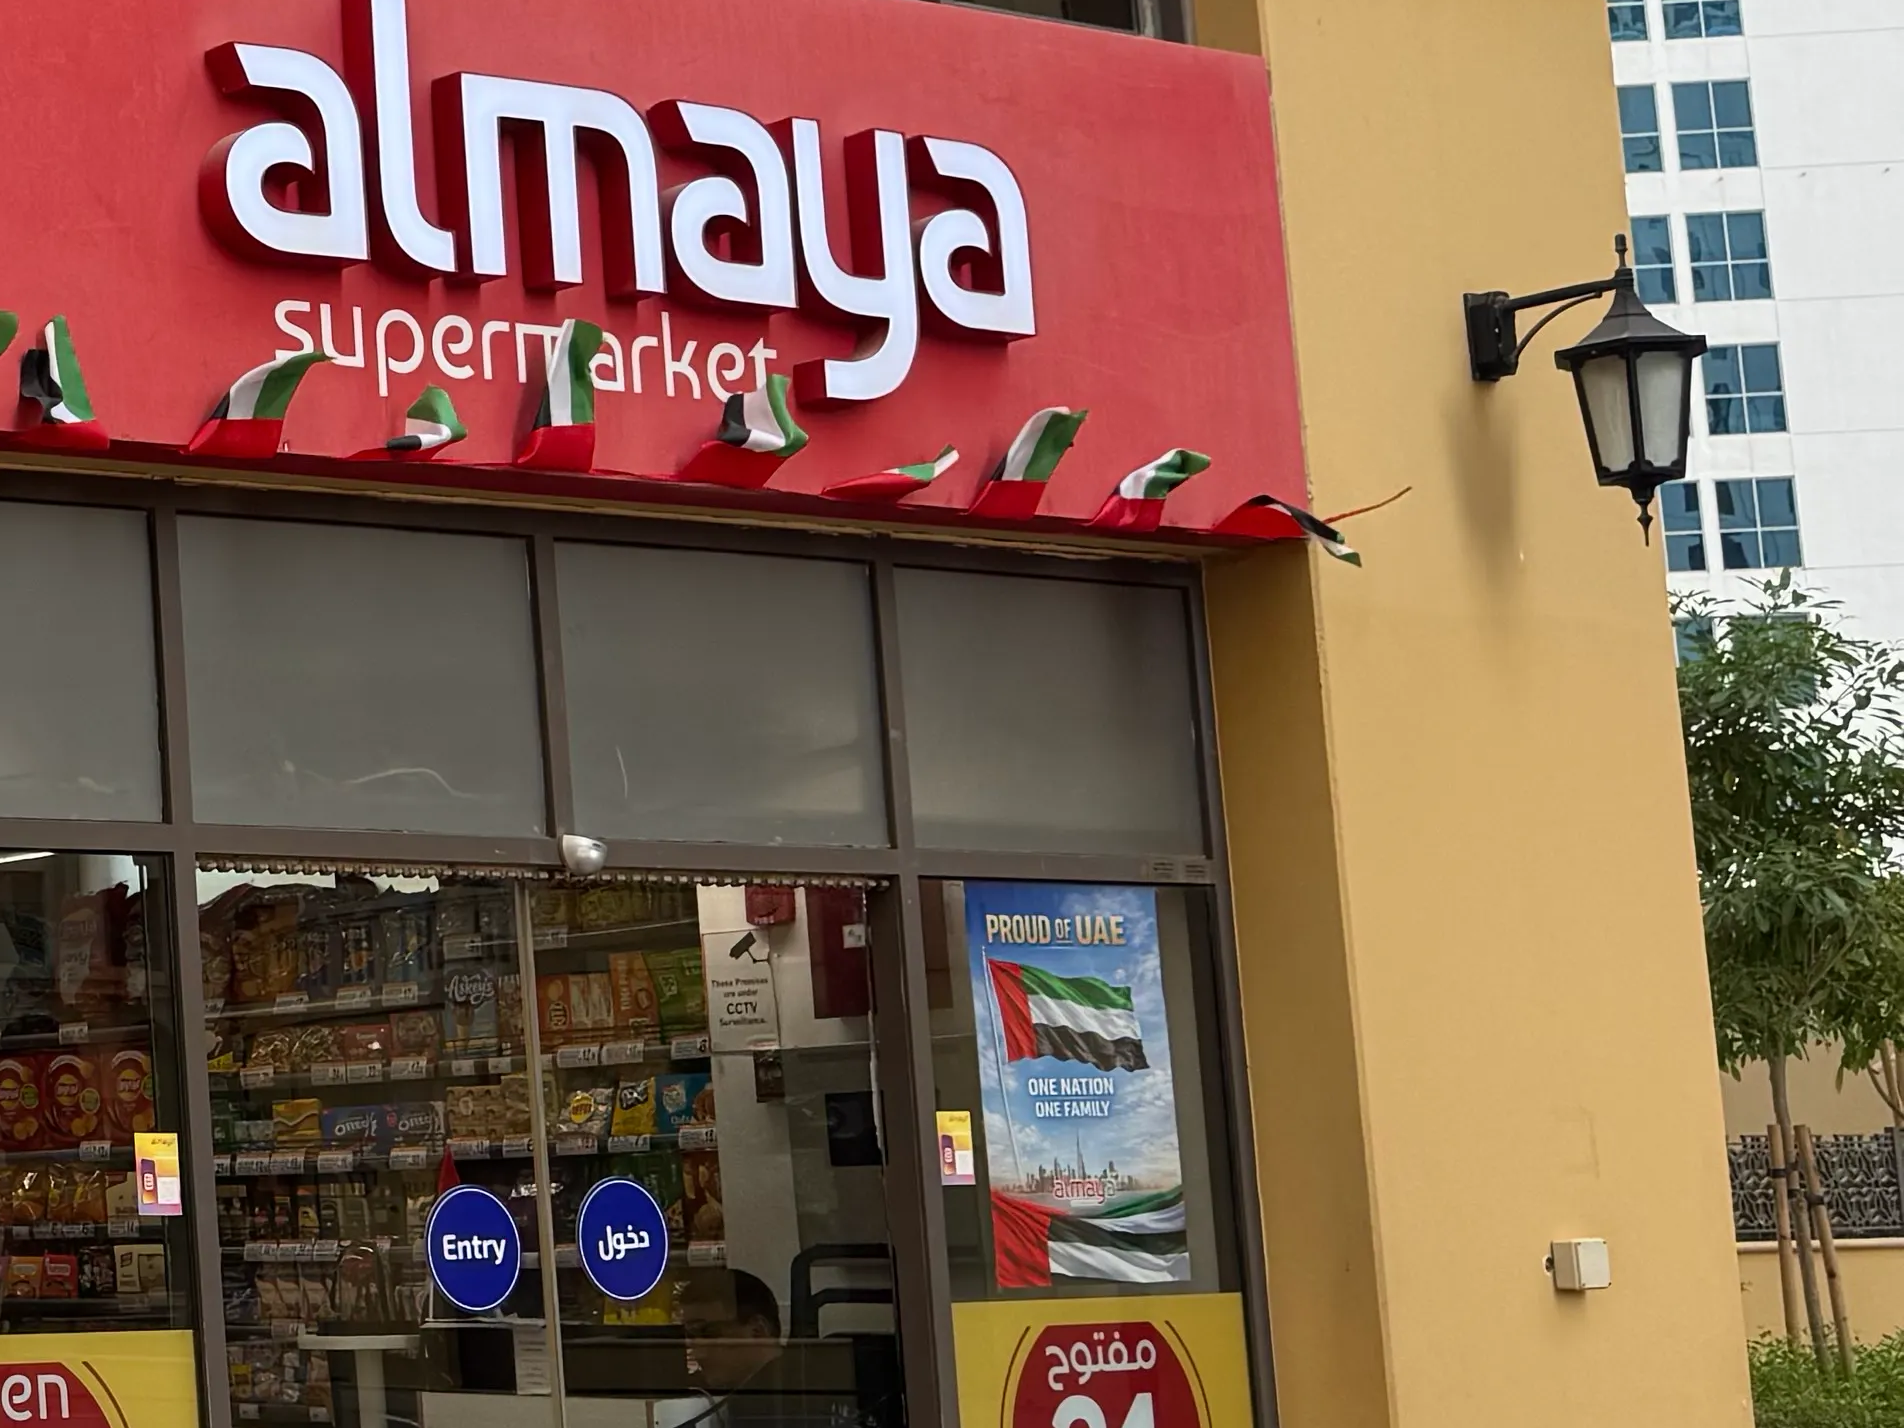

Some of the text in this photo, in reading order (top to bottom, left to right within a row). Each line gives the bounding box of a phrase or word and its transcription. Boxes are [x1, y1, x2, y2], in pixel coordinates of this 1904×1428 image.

[986, 914, 1126, 945] PROUD OF UAE
[726, 1001, 757, 1015] CCTV
[1028, 1077, 1114, 1096] ONE NATION
[1035, 1100, 1110, 1118] ONE FAMILY
[1052, 1174, 1117, 1205] almaya
[442, 1233, 507, 1265] Entry
[598, 1224, 651, 1261] دخول
[1044, 1331, 1158, 1392] مفتوح
